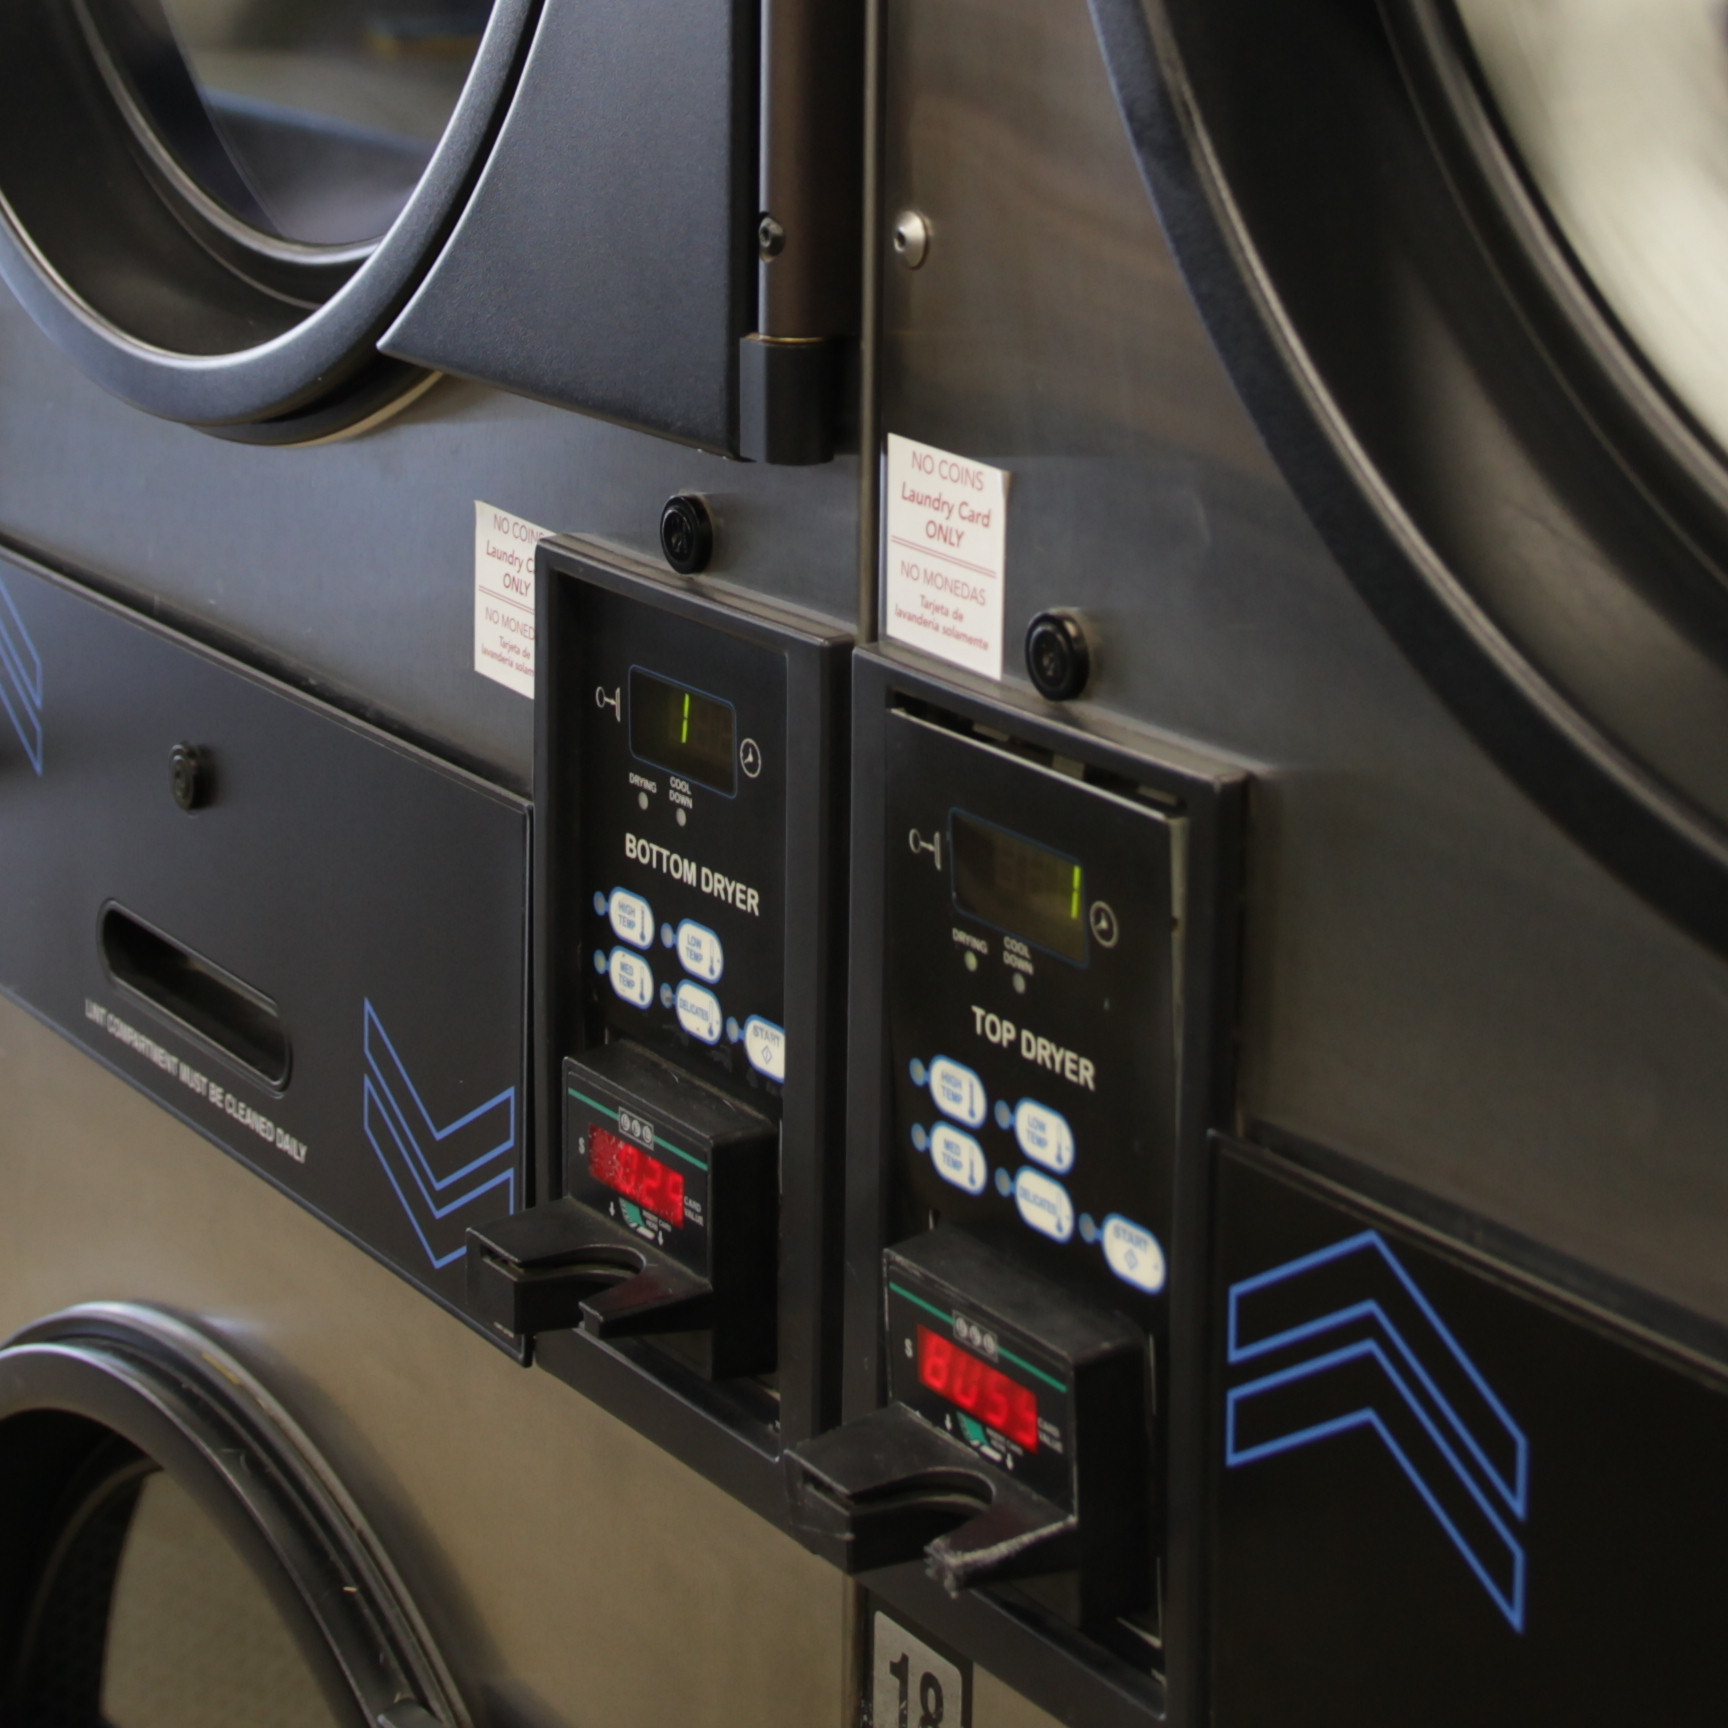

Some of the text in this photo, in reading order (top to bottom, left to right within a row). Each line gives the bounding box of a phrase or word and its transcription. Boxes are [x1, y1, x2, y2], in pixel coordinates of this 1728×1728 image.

[911, 451, 984, 491] NO COINS
[901, 482, 992, 528] Laundry Card
[493, 513, 509, 535] NO
[925, 520, 965, 548] ONLY
[486, 539, 523, 573] Laundry
[503, 572, 531, 597] ONLY
[900, 560, 987, 607] NO MONEDAS
[920, 594, 965, 623] Tarjeta de
[485, 606, 535, 641] NO MONED
[942, 622, 989, 651] solamente
[629, 772, 657, 794] DRYING
[670, 776, 692, 795] COOL
[669, 789, 693, 810] DOWN
[625, 832, 760, 917] BOTTOM DRYER
[618, 901, 636, 917] HIGH
[618, 914, 636, 931] TEMP
[687, 934, 702, 950] LOW
[952, 927, 988, 955] DRYING
[1004, 936, 1031, 960] COOL
[686, 947, 704, 964] TEMP
[1003, 950, 1034, 976] DOWN
[620, 961, 634, 977] MED
[618, 974, 635, 990] TEMP
[753, 1024, 781, 1046] START
[971, 1005, 1096, 1092] TOP DRYER
[85, 998, 308, 1164] LINT COMPARTMENT MUST BE CLEANED DAILY
[941, 1086, 963, 1105] TEMP
[1027, 1114, 1047, 1133] LOW
[943, 1138, 962, 1157] MED
[1026, 1129, 1048, 1150] TEMP
[942, 1152, 963, 1171] TEMP
[1113, 1223, 1149, 1252] START
